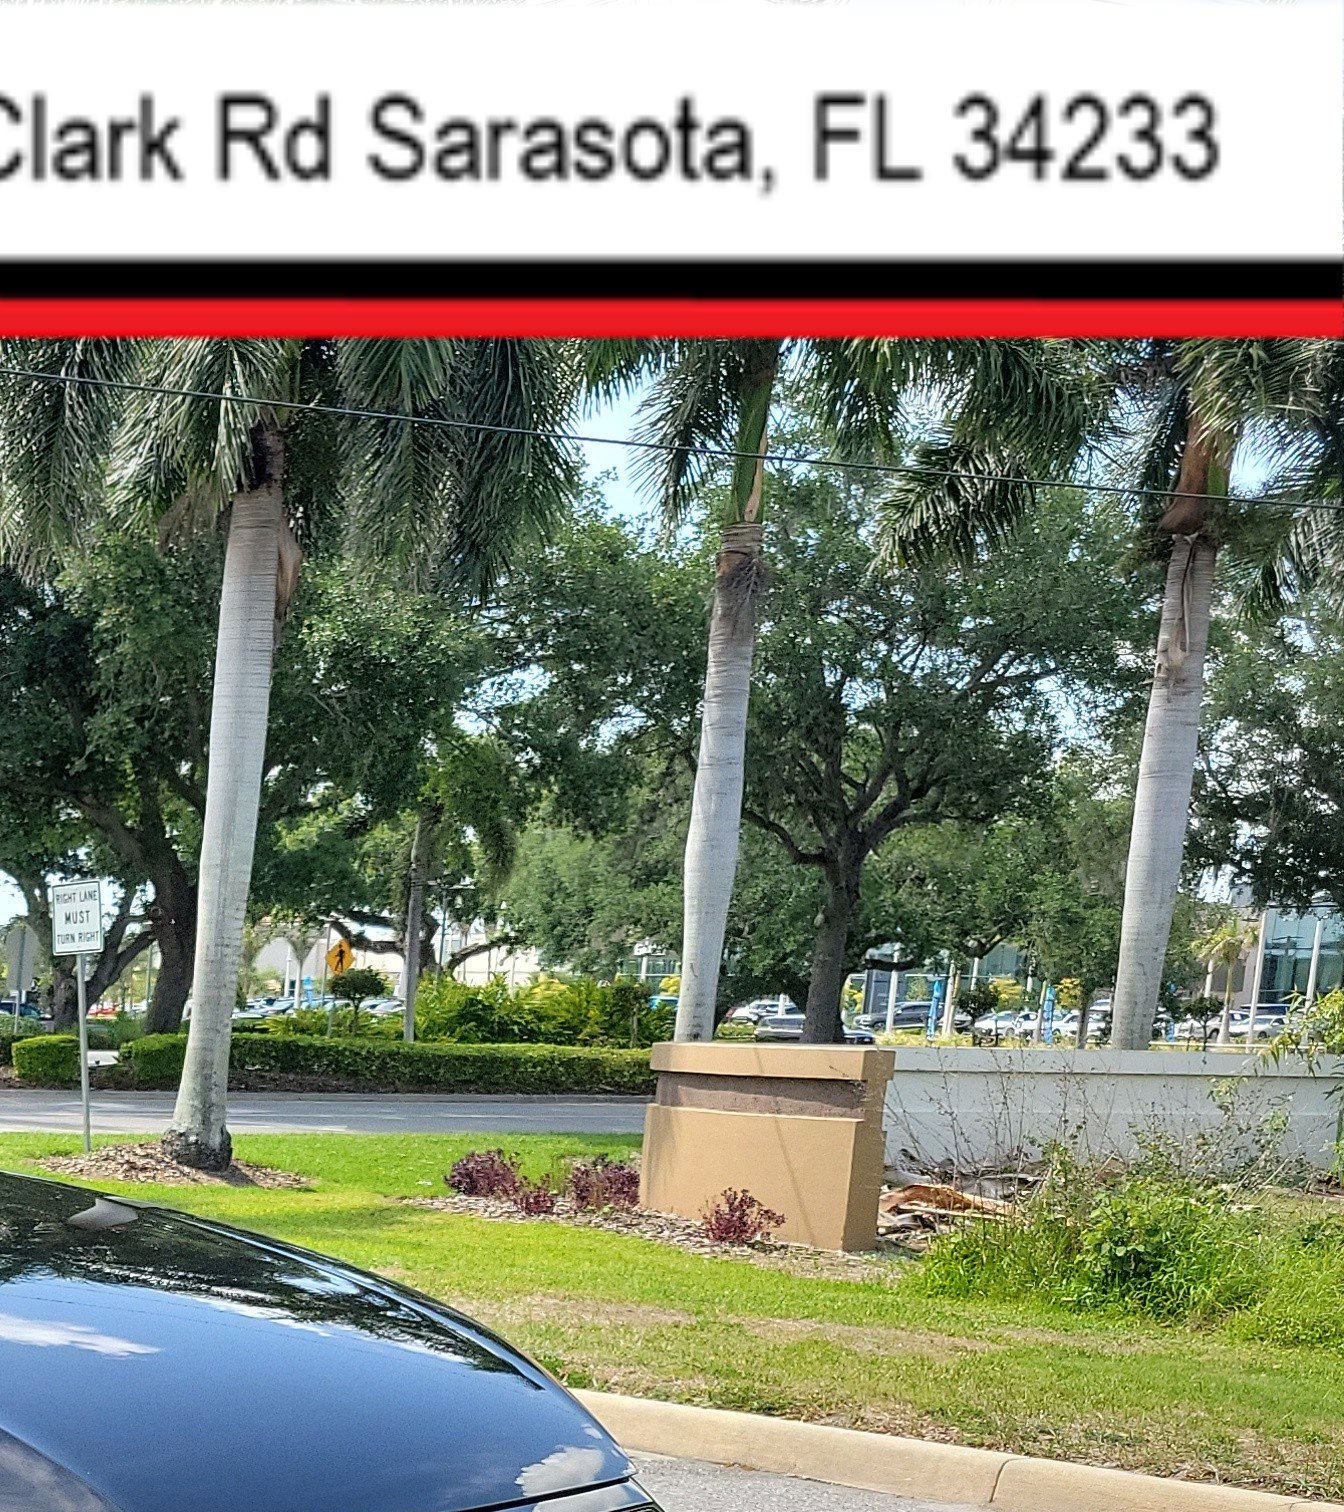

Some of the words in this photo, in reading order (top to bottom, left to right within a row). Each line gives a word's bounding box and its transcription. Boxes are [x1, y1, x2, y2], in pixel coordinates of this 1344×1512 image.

[56, 892, 76, 905] RIGHT
[79, 890, 98, 903] LANE
[64, 910, 90, 925] MUST
[57, 932, 75, 945] TURN
[78, 931, 99, 943] RIGHT
